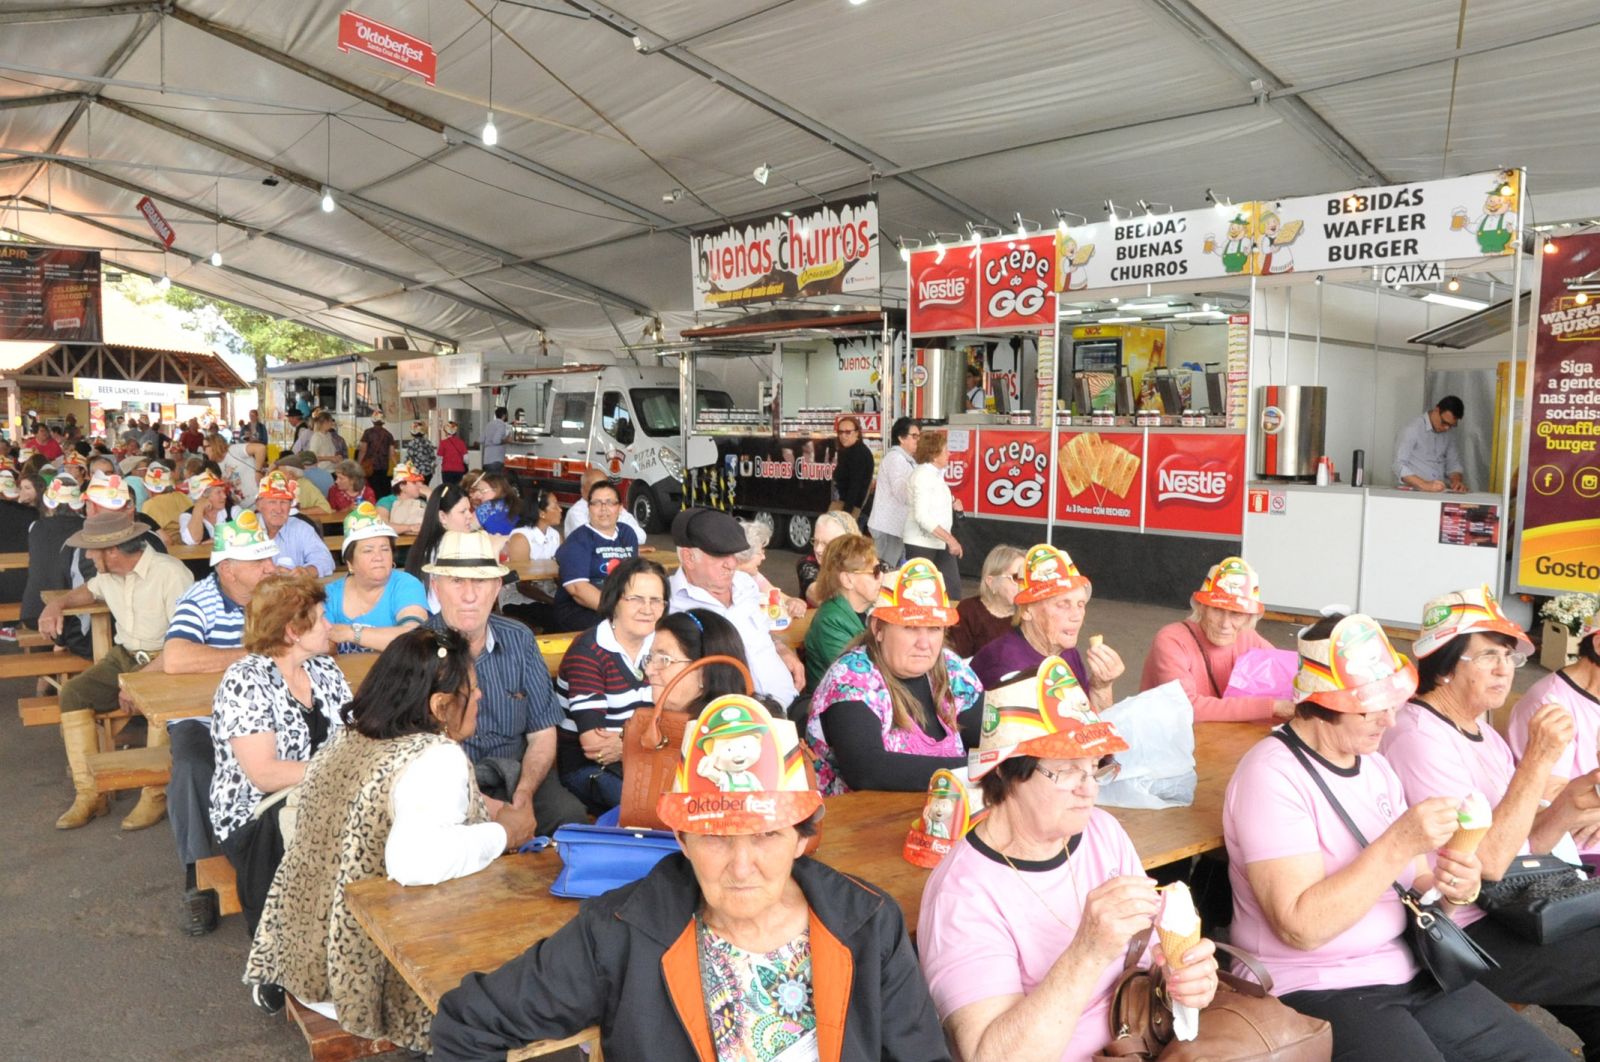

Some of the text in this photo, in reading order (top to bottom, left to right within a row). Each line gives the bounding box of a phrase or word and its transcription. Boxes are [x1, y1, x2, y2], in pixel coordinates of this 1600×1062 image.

[357, 25, 424, 62] Oktoberfest
[1323, 213, 1426, 239] WAFFLER
[1116, 239, 1184, 261] BUENAS
[1328, 238, 1419, 262] BURGER
[1110, 260, 1188, 281] CHURROS
[1384, 262, 1441, 284] CAIXA
[988, 285, 1045, 318] GG
[838, 351, 871, 371] buenas
[1560, 359, 1593, 377] Siga
[1547, 378, 1558, 389] a
[1539, 393, 1566, 404] nas
[1545, 406, 1600, 420] sociais:
[1546, 436, 1597, 454] burger
[755, 455, 793, 479] Buenas
[984, 441, 1047, 473] Crepe
[986, 478, 1043, 508] GG
[1535, 555, 1600, 580] Gosto
